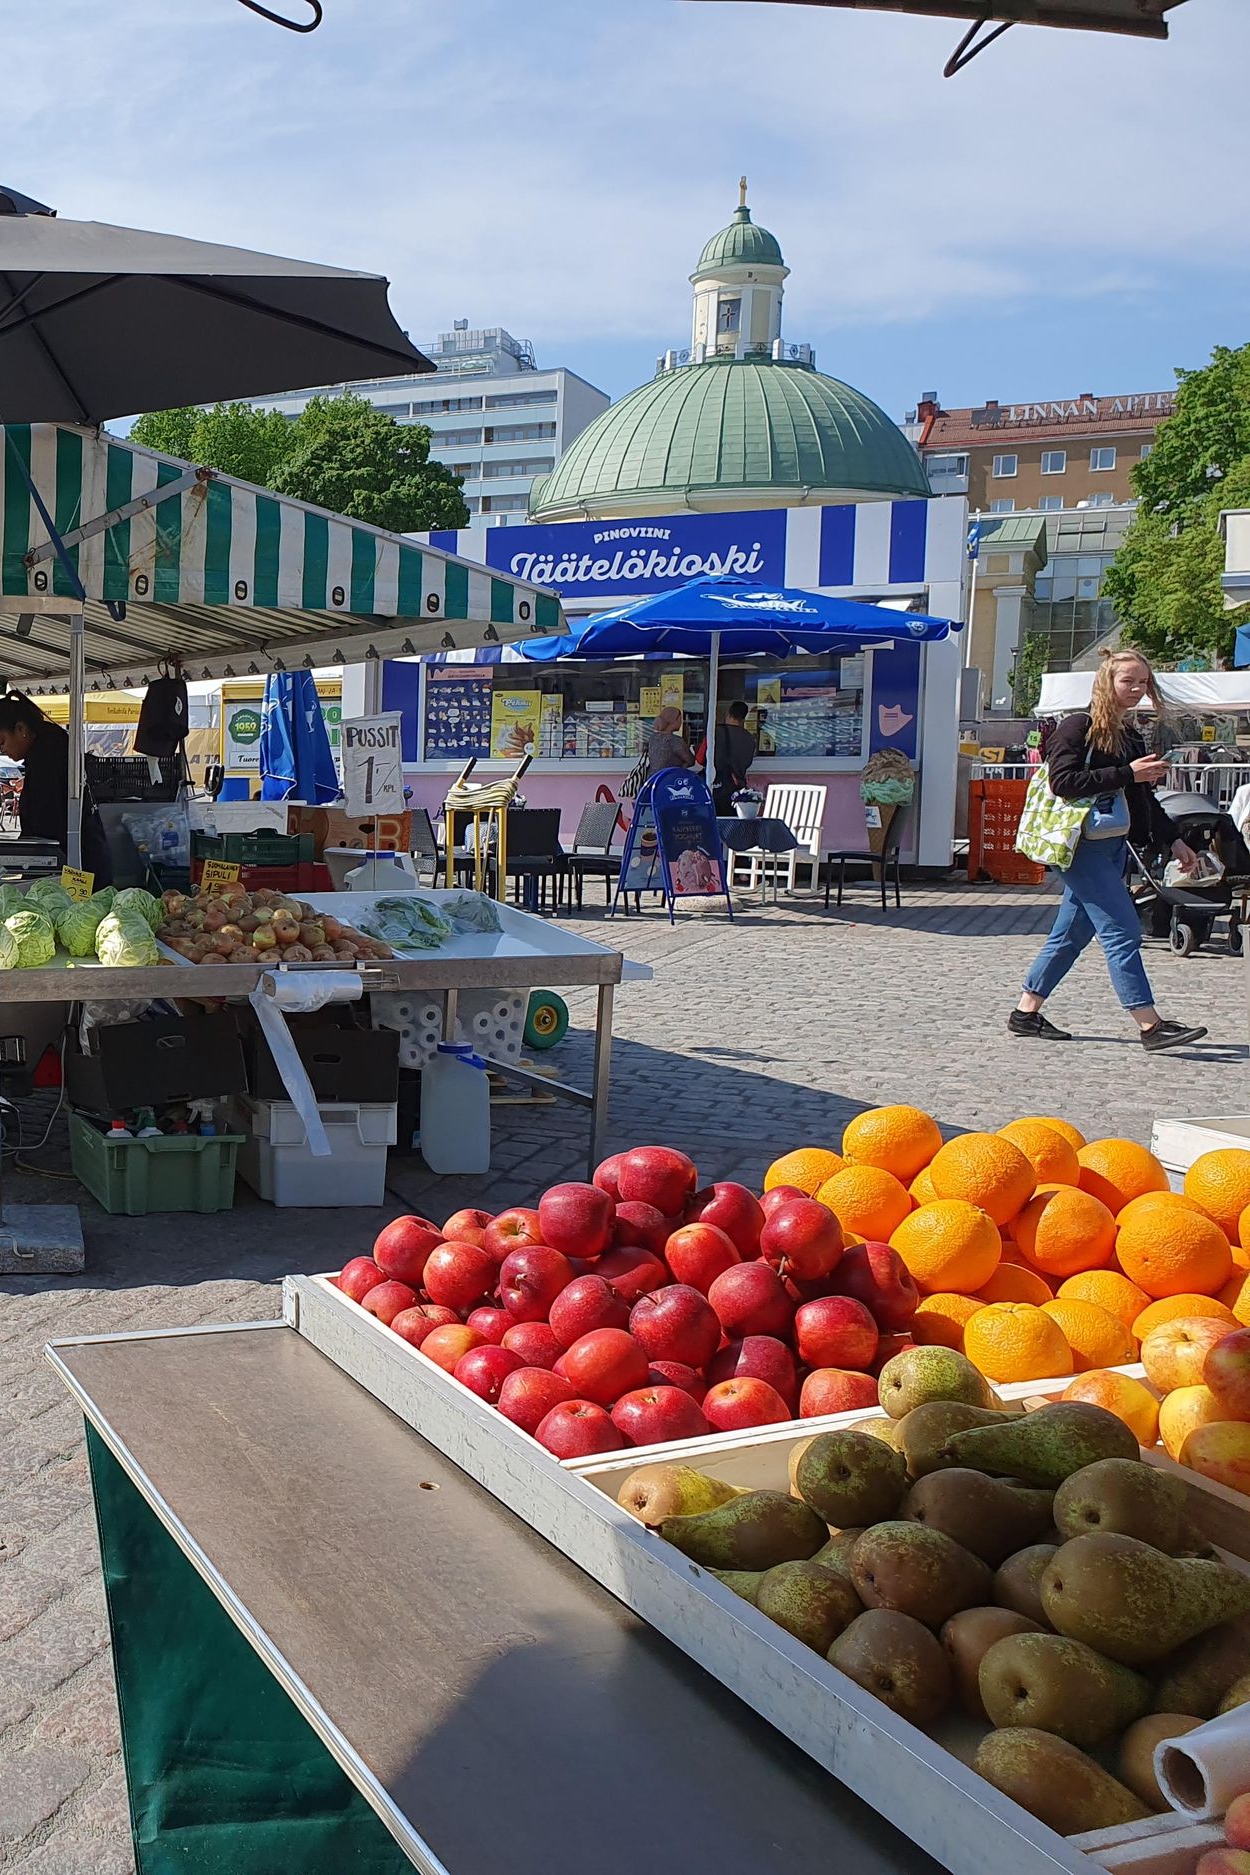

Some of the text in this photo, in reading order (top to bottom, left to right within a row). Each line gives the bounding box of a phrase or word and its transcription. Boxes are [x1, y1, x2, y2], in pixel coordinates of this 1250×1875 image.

[1008, 399, 1098, 421] LINNAN
[510, 543, 764, 584] Jäätelökioski
[346, 725, 398, 748] PUSSIT
[205, 870, 230, 880] SIPULI
